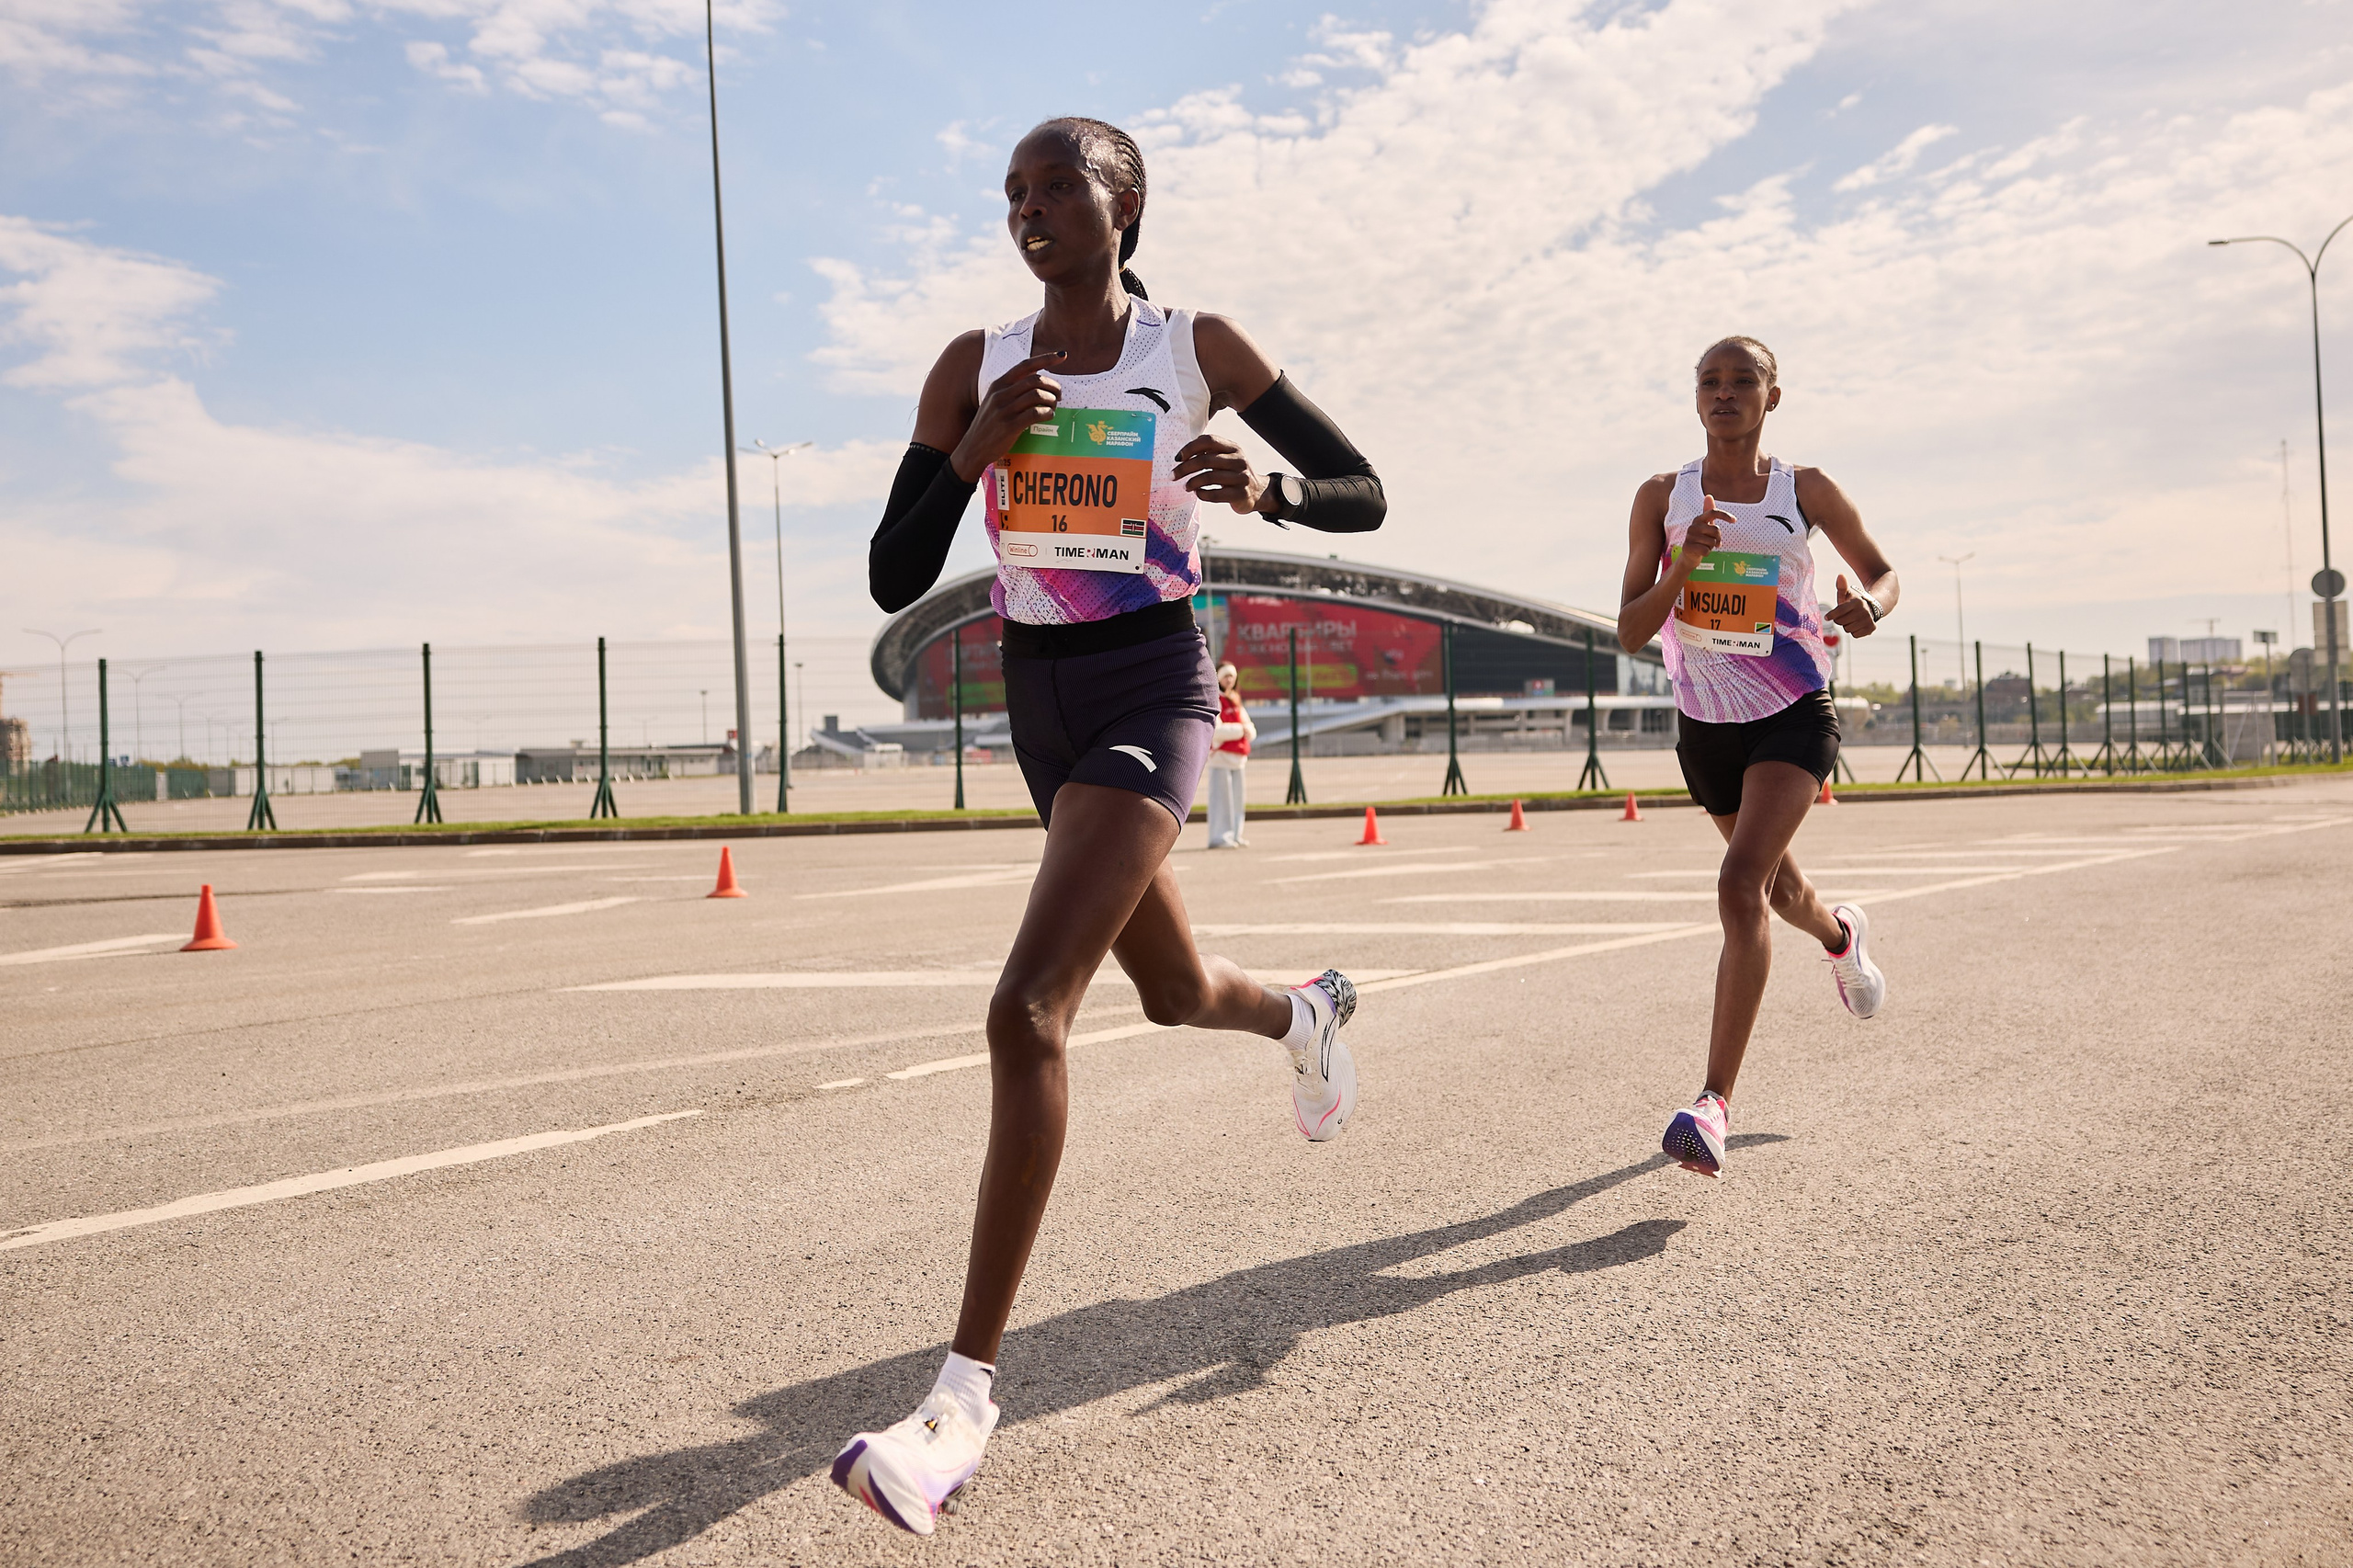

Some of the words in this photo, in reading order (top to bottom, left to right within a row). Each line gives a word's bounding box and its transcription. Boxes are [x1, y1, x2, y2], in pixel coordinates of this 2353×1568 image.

[1013, 471, 1118, 508] CHERONO
[1051, 515, 1068, 532] 16
[1690, 590, 1746, 616] MSUADI
[1711, 619, 1722, 631] 17
